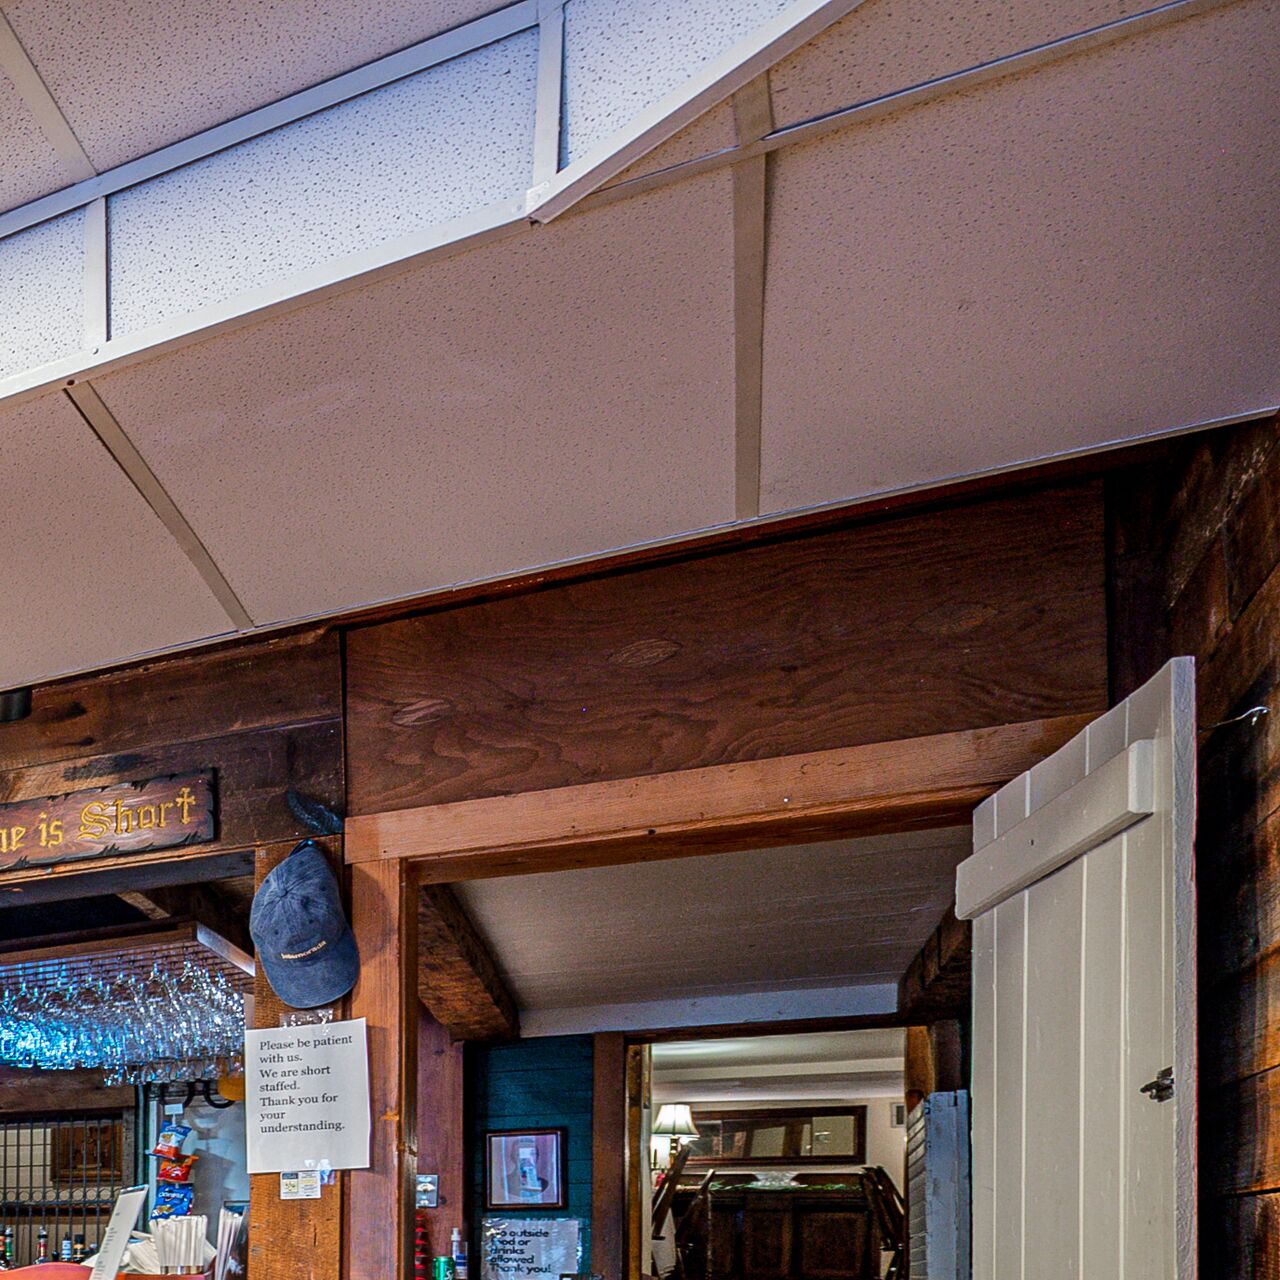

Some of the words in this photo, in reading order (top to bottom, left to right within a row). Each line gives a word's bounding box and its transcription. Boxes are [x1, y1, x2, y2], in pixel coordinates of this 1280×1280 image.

[40, 811, 63, 849] is
[77, 786, 196, 841] Short
[259, 1039, 295, 1051] Please
[297, 1038, 310, 1049] be
[313, 1034, 353, 1050] patient
[259, 1053, 285, 1064] with
[286, 1055, 303, 1063] us.
[259, 1068, 278, 1079] We
[280, 1069, 299, 1078] are
[300, 1065, 331, 1077] short
[259, 1081, 301, 1093] staffed.
[259, 1096, 295, 1108] Thank
[297, 1096, 319, 1107] you
[321, 1092, 339, 1104] for
[259, 1110, 286, 1122] your
[260, 1122, 345, 1134] understanding.
[509, 1229, 549, 1237] outside
[517, 1239, 531, 1247] or
[490, 1255, 535, 1265] allowed
[490, 1263, 524, 1272] Thank
[527, 1265, 552, 1275] you!
